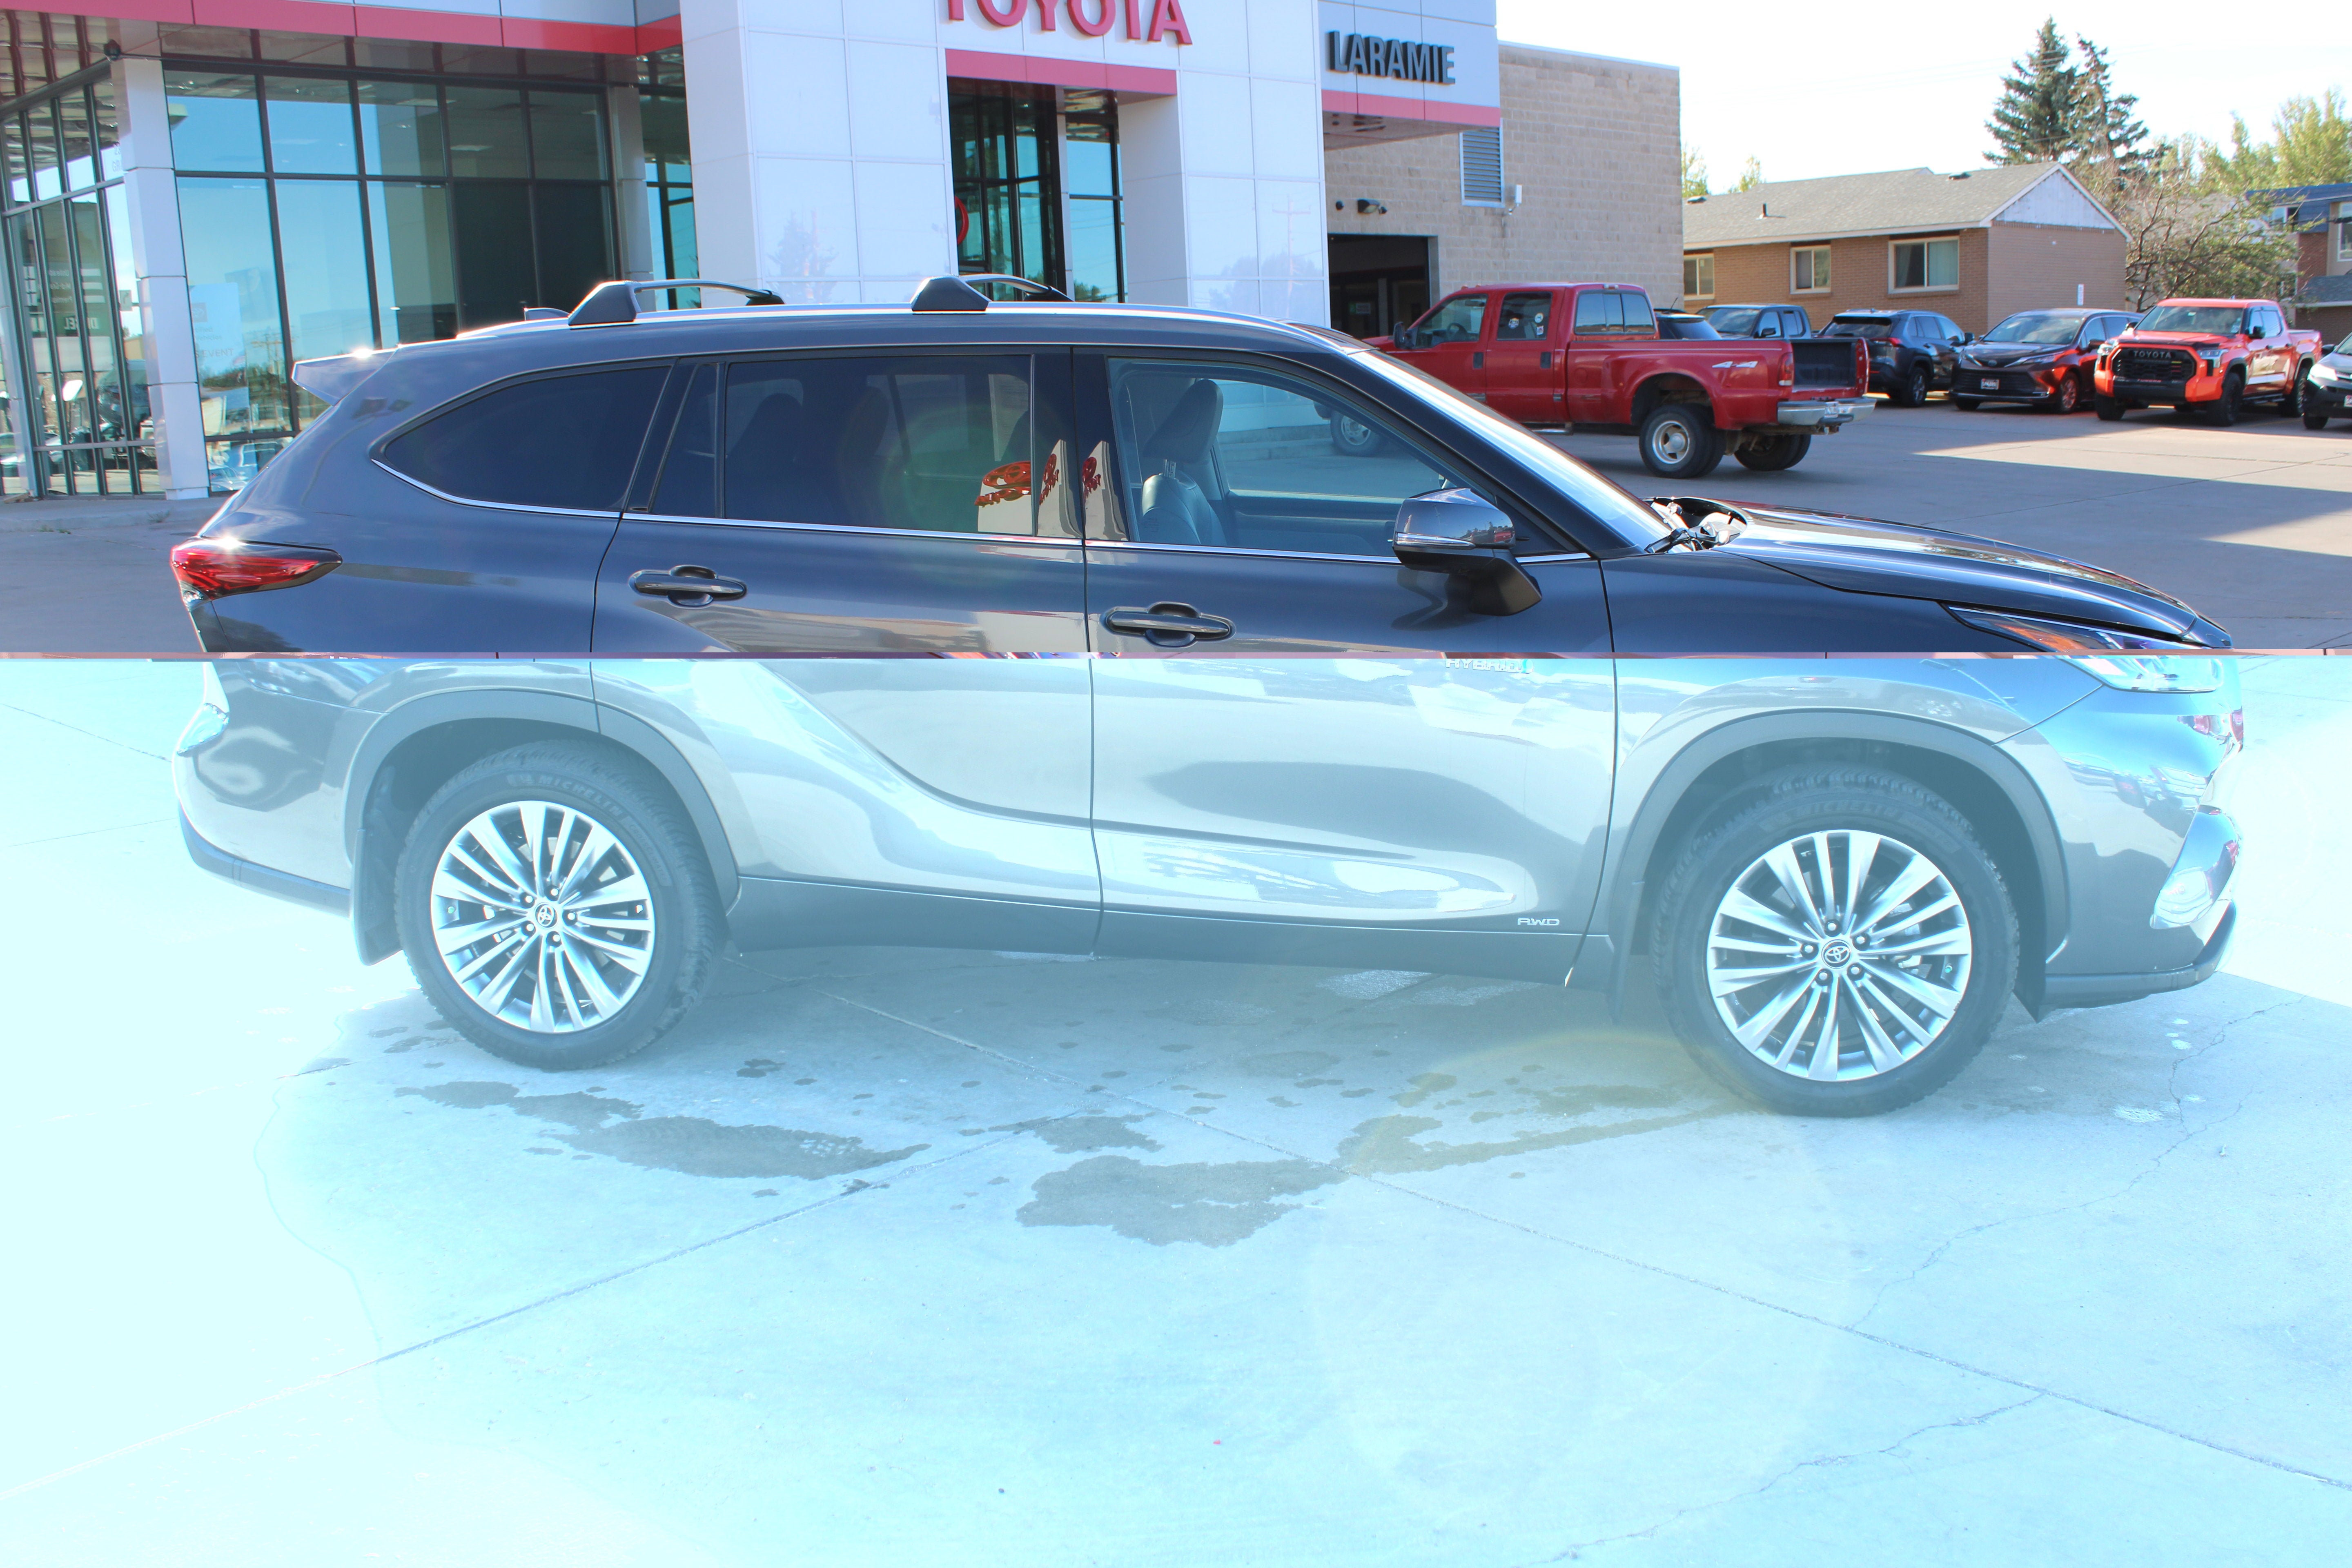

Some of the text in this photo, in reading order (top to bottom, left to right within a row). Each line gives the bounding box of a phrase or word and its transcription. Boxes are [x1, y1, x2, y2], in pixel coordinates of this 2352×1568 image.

[1329, 31, 1455, 84] LARAMIE
[1445, 658, 1521, 673] HYBRID
[539, 775, 623, 816] MICHELIN
